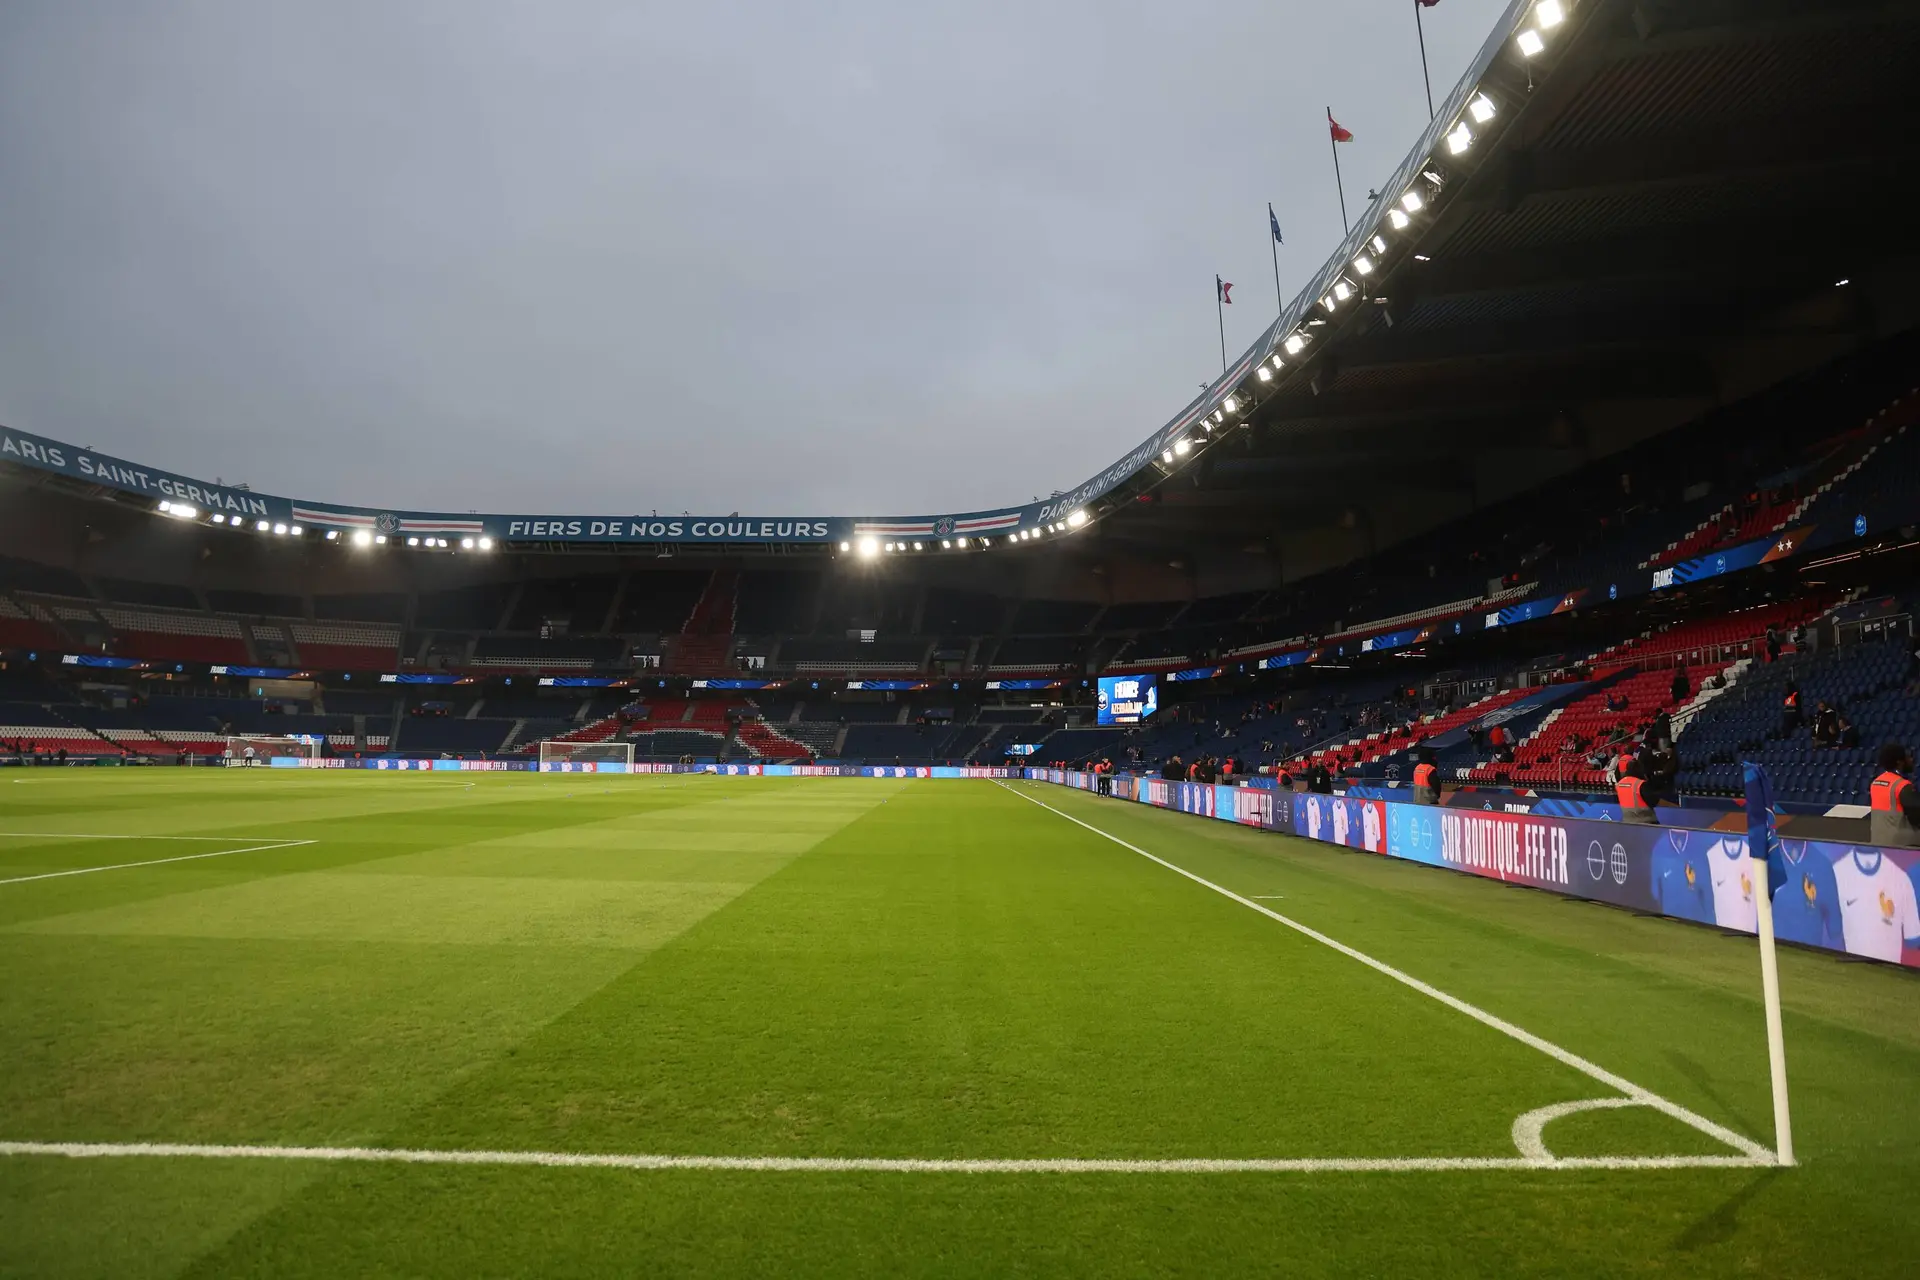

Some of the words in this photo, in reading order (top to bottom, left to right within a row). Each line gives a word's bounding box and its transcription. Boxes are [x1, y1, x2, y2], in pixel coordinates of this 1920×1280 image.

[1, 436, 66, 467] ARIS
[77, 456, 268, 515] SAINT-GERMAIN
[1037, 492, 1079, 522] PARIS
[1079, 432, 1165, 503] SAINT-GERMAIN
[508, 521, 582, 536] FIERS
[590, 521, 623, 536] DE
[630, 521, 683, 537] NOS
[691, 522, 828, 537] COULEURS
[1653, 568, 1674, 588] FRANCE
[210, 665, 228, 674] FRANCE
[380, 674, 397, 682] FRANCE
[538, 678, 555, 686] FRANCE
[692, 680, 708, 688] FRANCE
[847, 681, 863, 689] FRANCE
[1440, 814, 1462, 862] SUR
[1464, 817, 1569, 884] BOUTIQUE.FFF.FR
